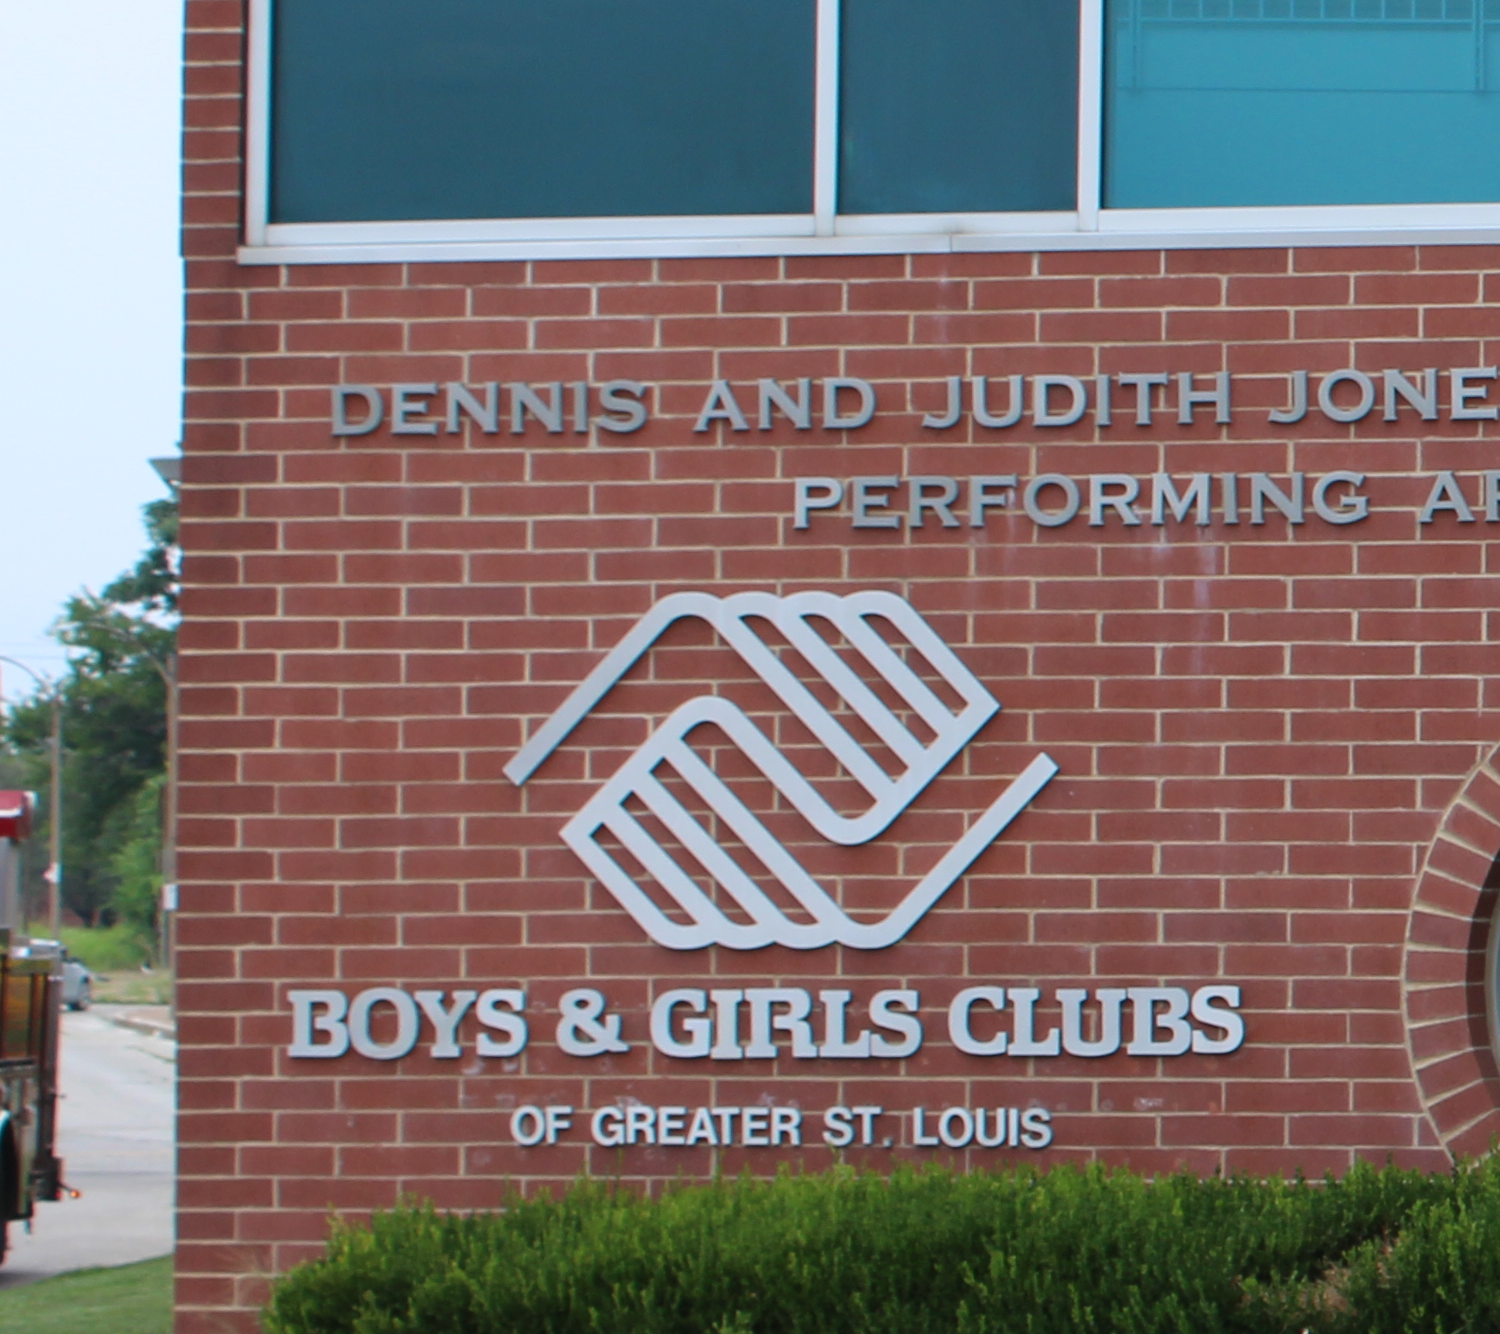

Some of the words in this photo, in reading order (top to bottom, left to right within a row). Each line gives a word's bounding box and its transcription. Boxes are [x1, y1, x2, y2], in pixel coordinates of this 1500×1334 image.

[330, 379, 648, 437] DENNIS
[693, 375, 876, 432] AND
[922, 371, 1232, 429] JUDITH
[794, 471, 1370, 530] PERFORMING
[287, 987, 529, 1059] BOYS
[556, 988, 629, 1055] &
[649, 987, 922, 1059] GIRLS
[946, 983, 1244, 1056] CLUBS
[510, 1105, 572, 1146] OF
[591, 1105, 801, 1147] GREATER
[822, 1105, 893, 1148] ST.
[912, 1105, 1053, 1148] LOUIS
